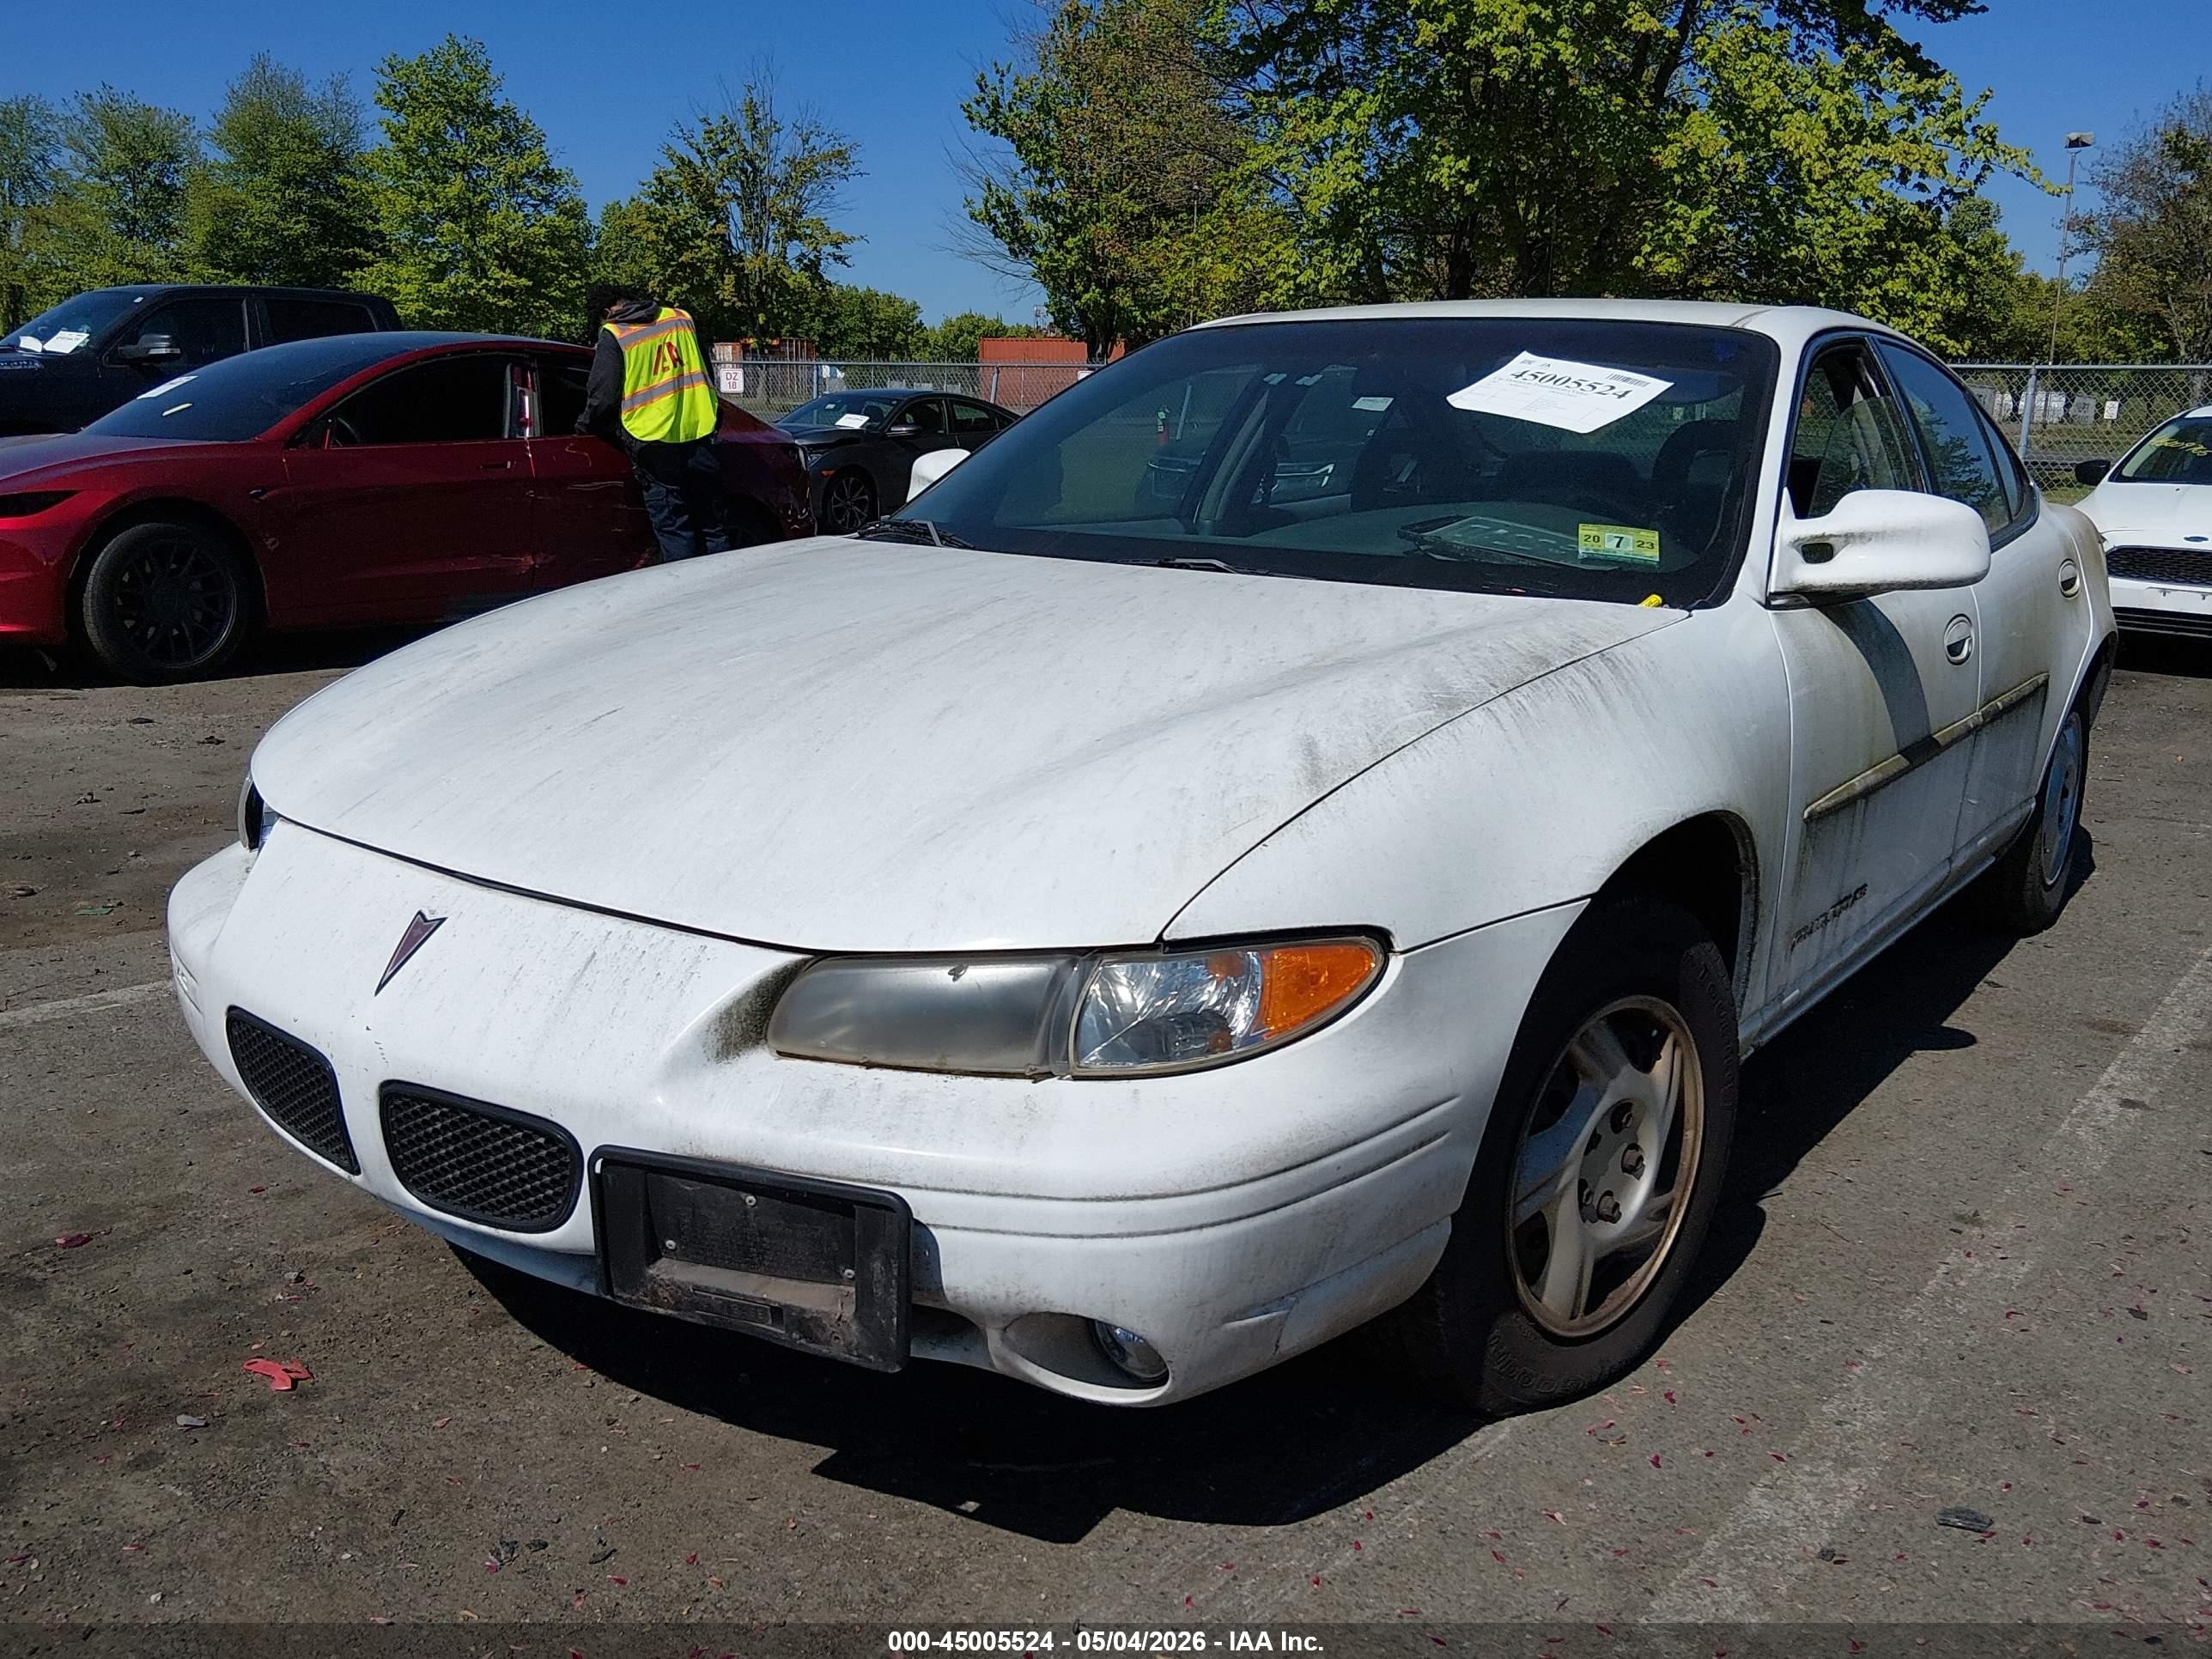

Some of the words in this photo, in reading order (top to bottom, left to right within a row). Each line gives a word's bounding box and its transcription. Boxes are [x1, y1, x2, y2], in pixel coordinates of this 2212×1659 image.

[1510, 368, 1634, 400] 45005524
[1583, 534, 1601, 544] 20
[1613, 535, 1625, 549] 7
[1636, 539, 1656, 550] 23
